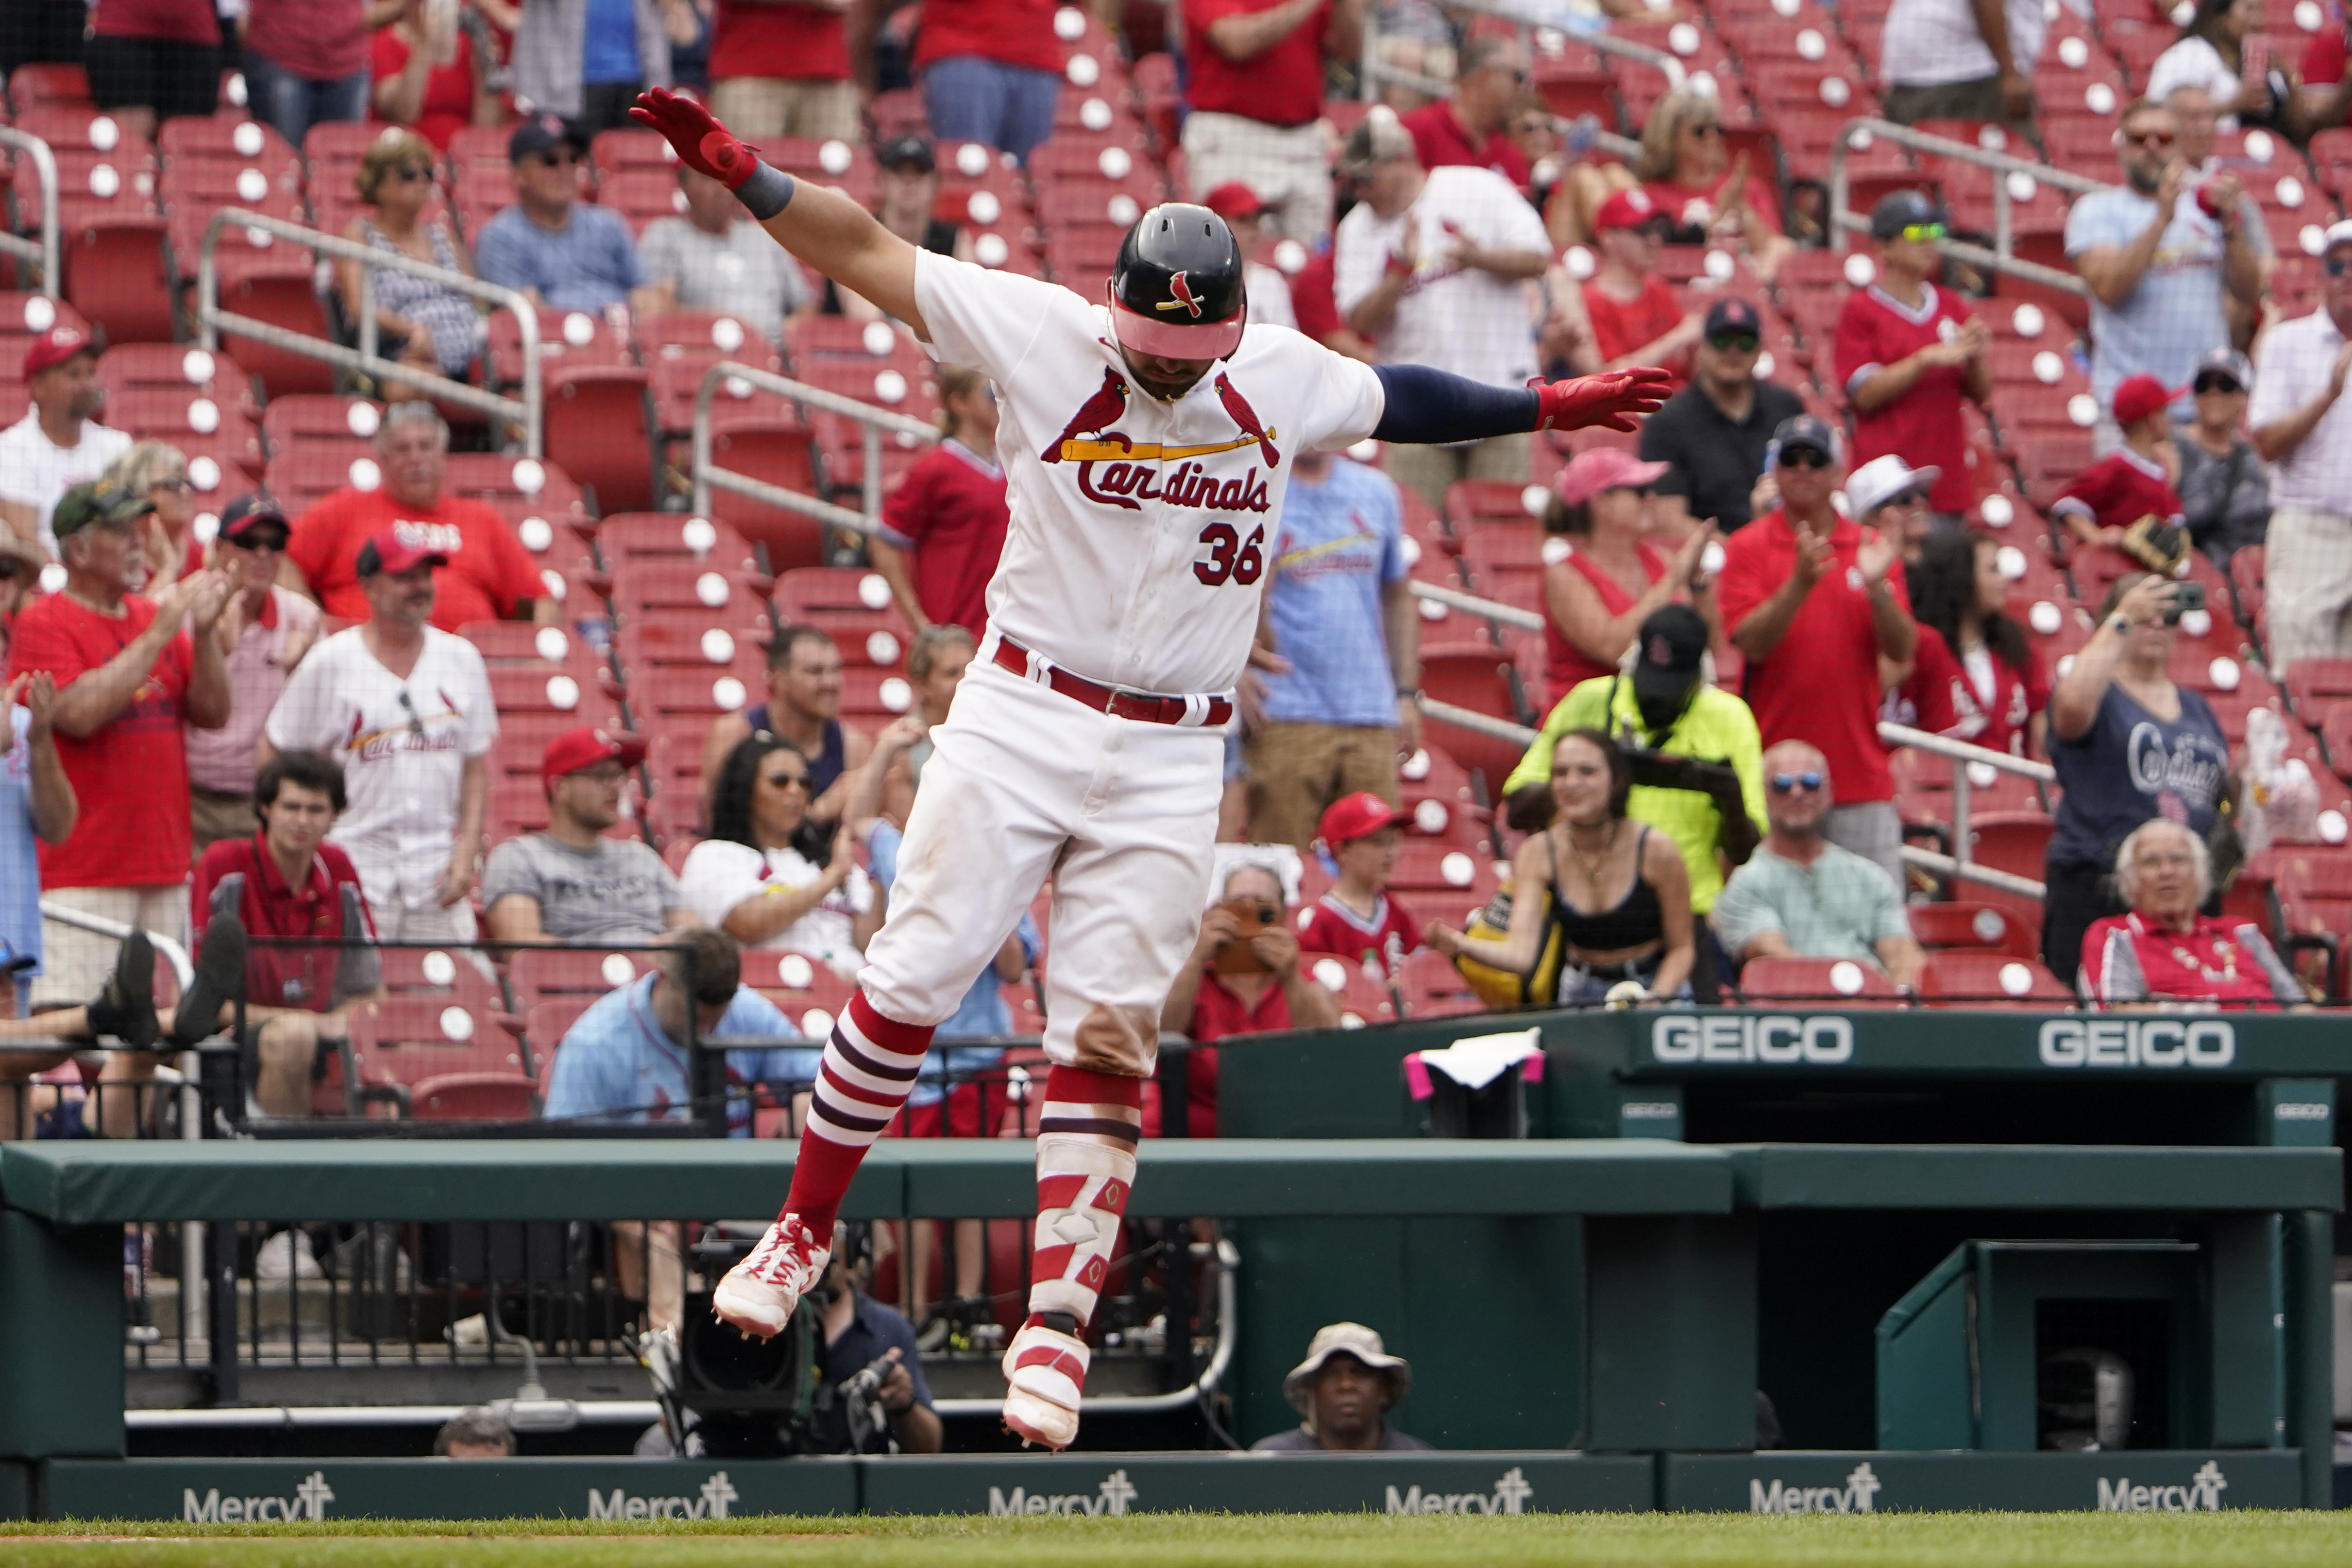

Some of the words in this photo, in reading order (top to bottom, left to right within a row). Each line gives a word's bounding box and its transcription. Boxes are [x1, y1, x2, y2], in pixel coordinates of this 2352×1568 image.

[1078, 432, 1271, 514] Cardinals
[1193, 522, 1264, 586] 36
[1652, 1015, 1854, 1062] GEICO
[2039, 1020, 2234, 1067] GEICO
[1622, 1102, 1678, 1118] GEICO
[2274, 1103, 2329, 1119] GEICO
